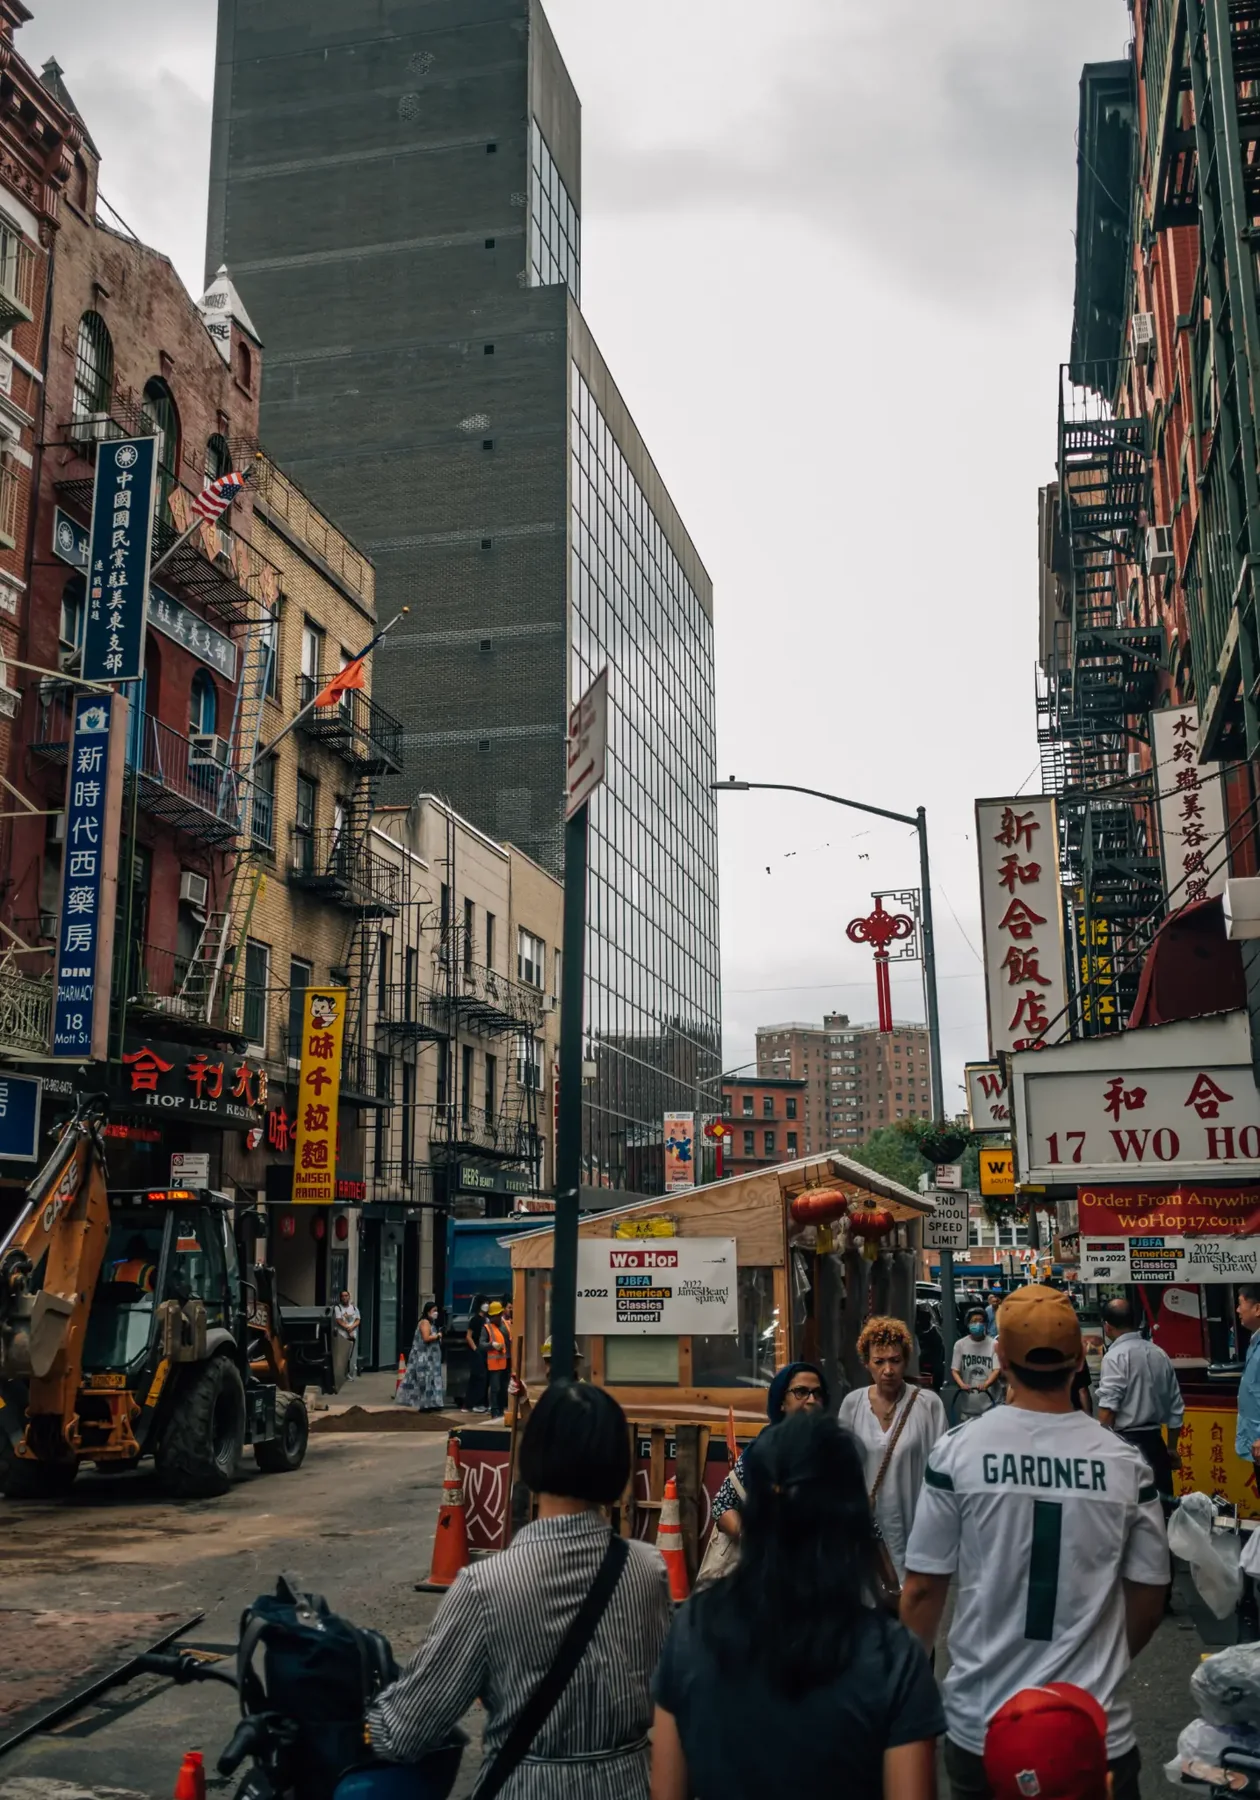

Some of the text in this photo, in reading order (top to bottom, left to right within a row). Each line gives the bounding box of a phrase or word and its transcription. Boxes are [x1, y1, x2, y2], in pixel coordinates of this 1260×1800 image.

[102, 471, 133, 675] 中國國民黨駐美東支部
[65, 746, 103, 952] 新時代西藥房
[994, 806, 1052, 1041] 新和合飯店
[61, 967, 92, 977] DIN
[57, 985, 94, 1002] PHARMACY
[65, 1013, 83, 1030] 18
[54, 1032, 91, 1045] Mott St.
[146, 1093, 185, 1108] HOP
[189, 1098, 218, 1112] LEE
[301, 1032, 335, 1169] 味千拉麵
[1046, 1131, 1087, 1164] 17
[1109, 1127, 1180, 1162] WO
[295, 1173, 331, 1184] AJISEN
[463, 1168, 479, 1187] HERS
[44, 1159, 78, 1232] CASE
[295, 1187, 331, 1199] RAMEN
[935, 1196, 956, 1206] END
[1082, 1192, 1260, 1208] Order From Anywhe
[928, 1222, 963, 1232] SPEED
[1118, 1213, 1246, 1229] WoHop17.com
[932, 1235, 958, 1245] LIMIT
[1131, 1238, 1164, 1247] #JBFA
[1131, 1249, 1183, 1258] America's
[1194, 1243, 1220, 1255] 2022
[953, 1252, 971, 1262] AFE
[1132, 1261, 1176, 1269] Classics
[618, 1276, 651, 1285] #JBFA
[1133, 1271, 1173, 1280] winner!
[683, 1280, 702, 1289] 2022
[584, 1289, 608, 1298] 2022
[618, 1288, 670, 1298] America's
[618, 1300, 662, 1310] Classics
[618, 1312, 659, 1322] winner!
[962, 1354, 993, 1370] TORONT
[983, 1453, 1107, 1492] GARDNER
[1024, 1500, 1063, 1642] 1
